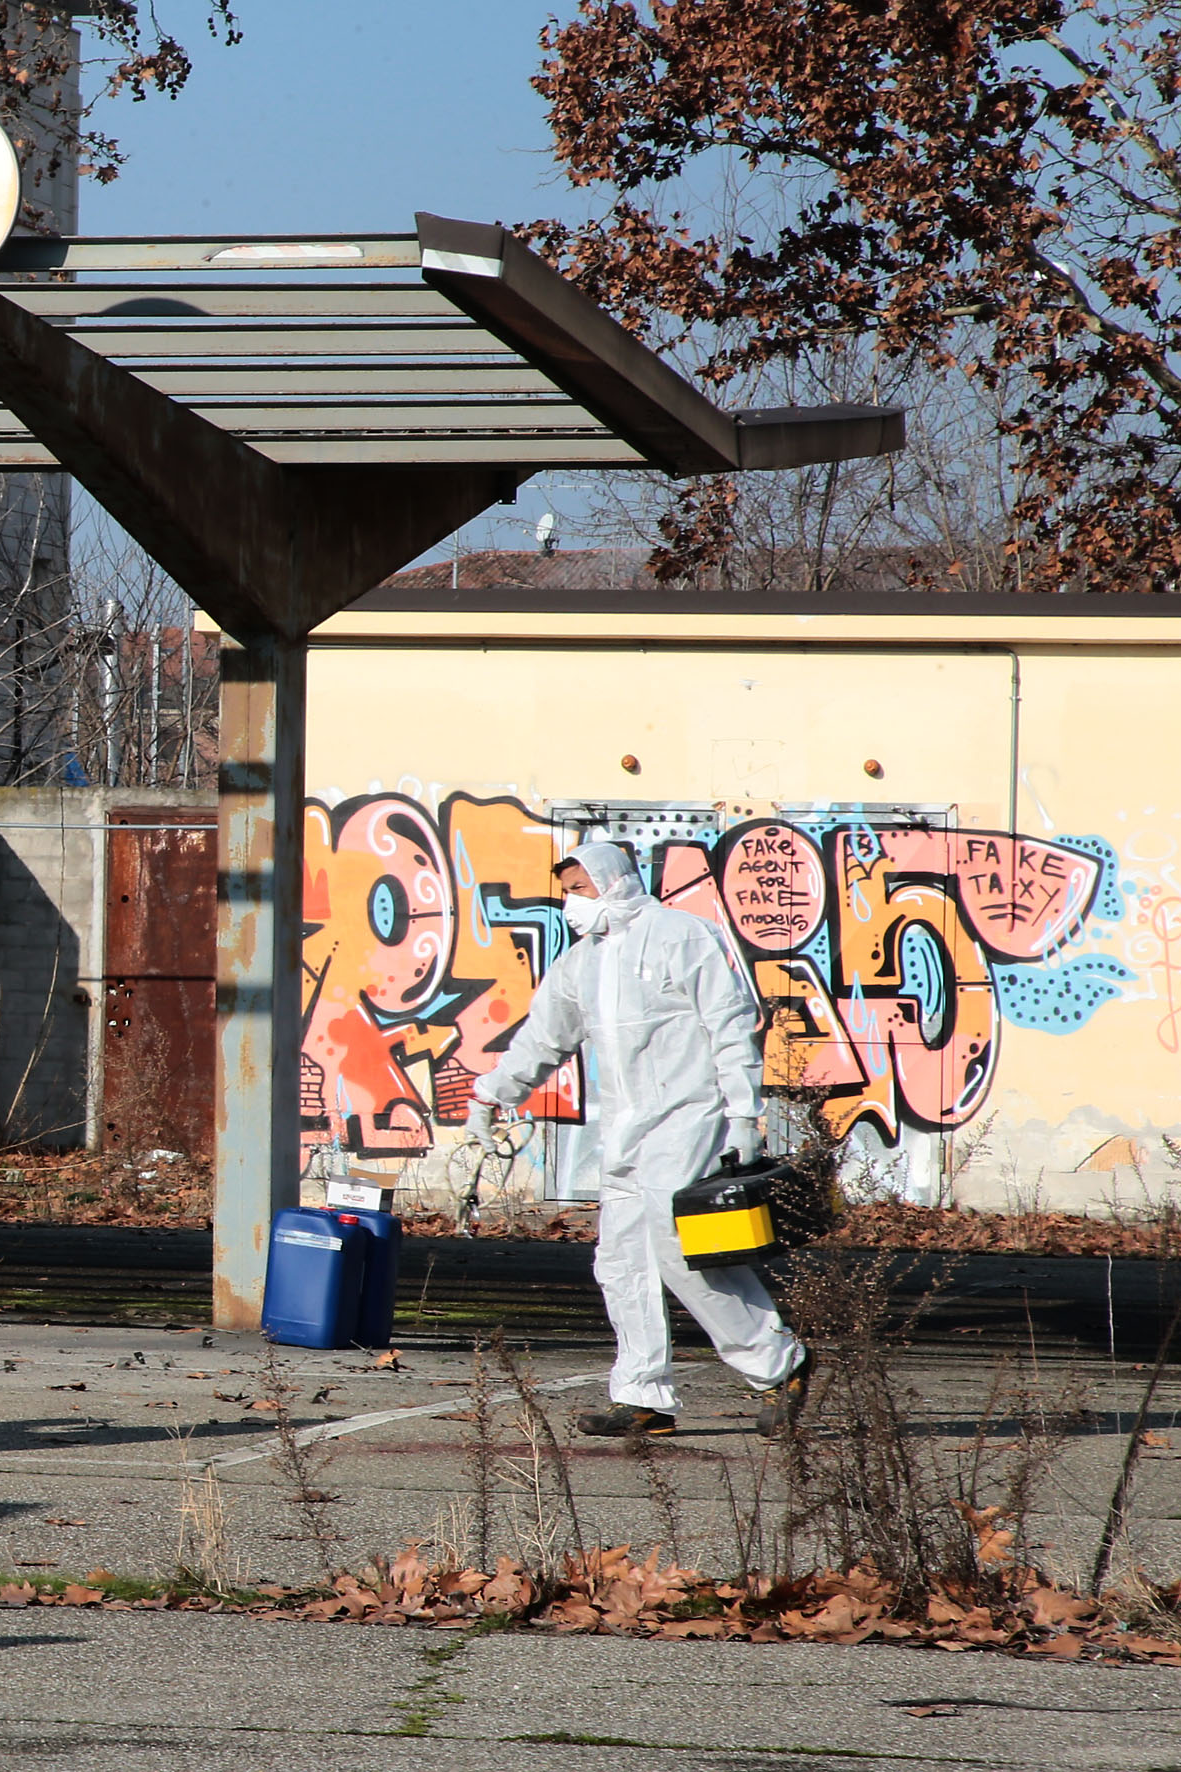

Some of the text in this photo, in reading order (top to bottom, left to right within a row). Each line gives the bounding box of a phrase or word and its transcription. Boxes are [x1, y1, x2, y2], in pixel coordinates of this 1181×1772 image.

[966, 839, 1066, 880] FAKE
[756, 876, 790, 890] FOR
[736, 890, 810, 907] FAKE
[967, 872, 1061, 927] TAXY
